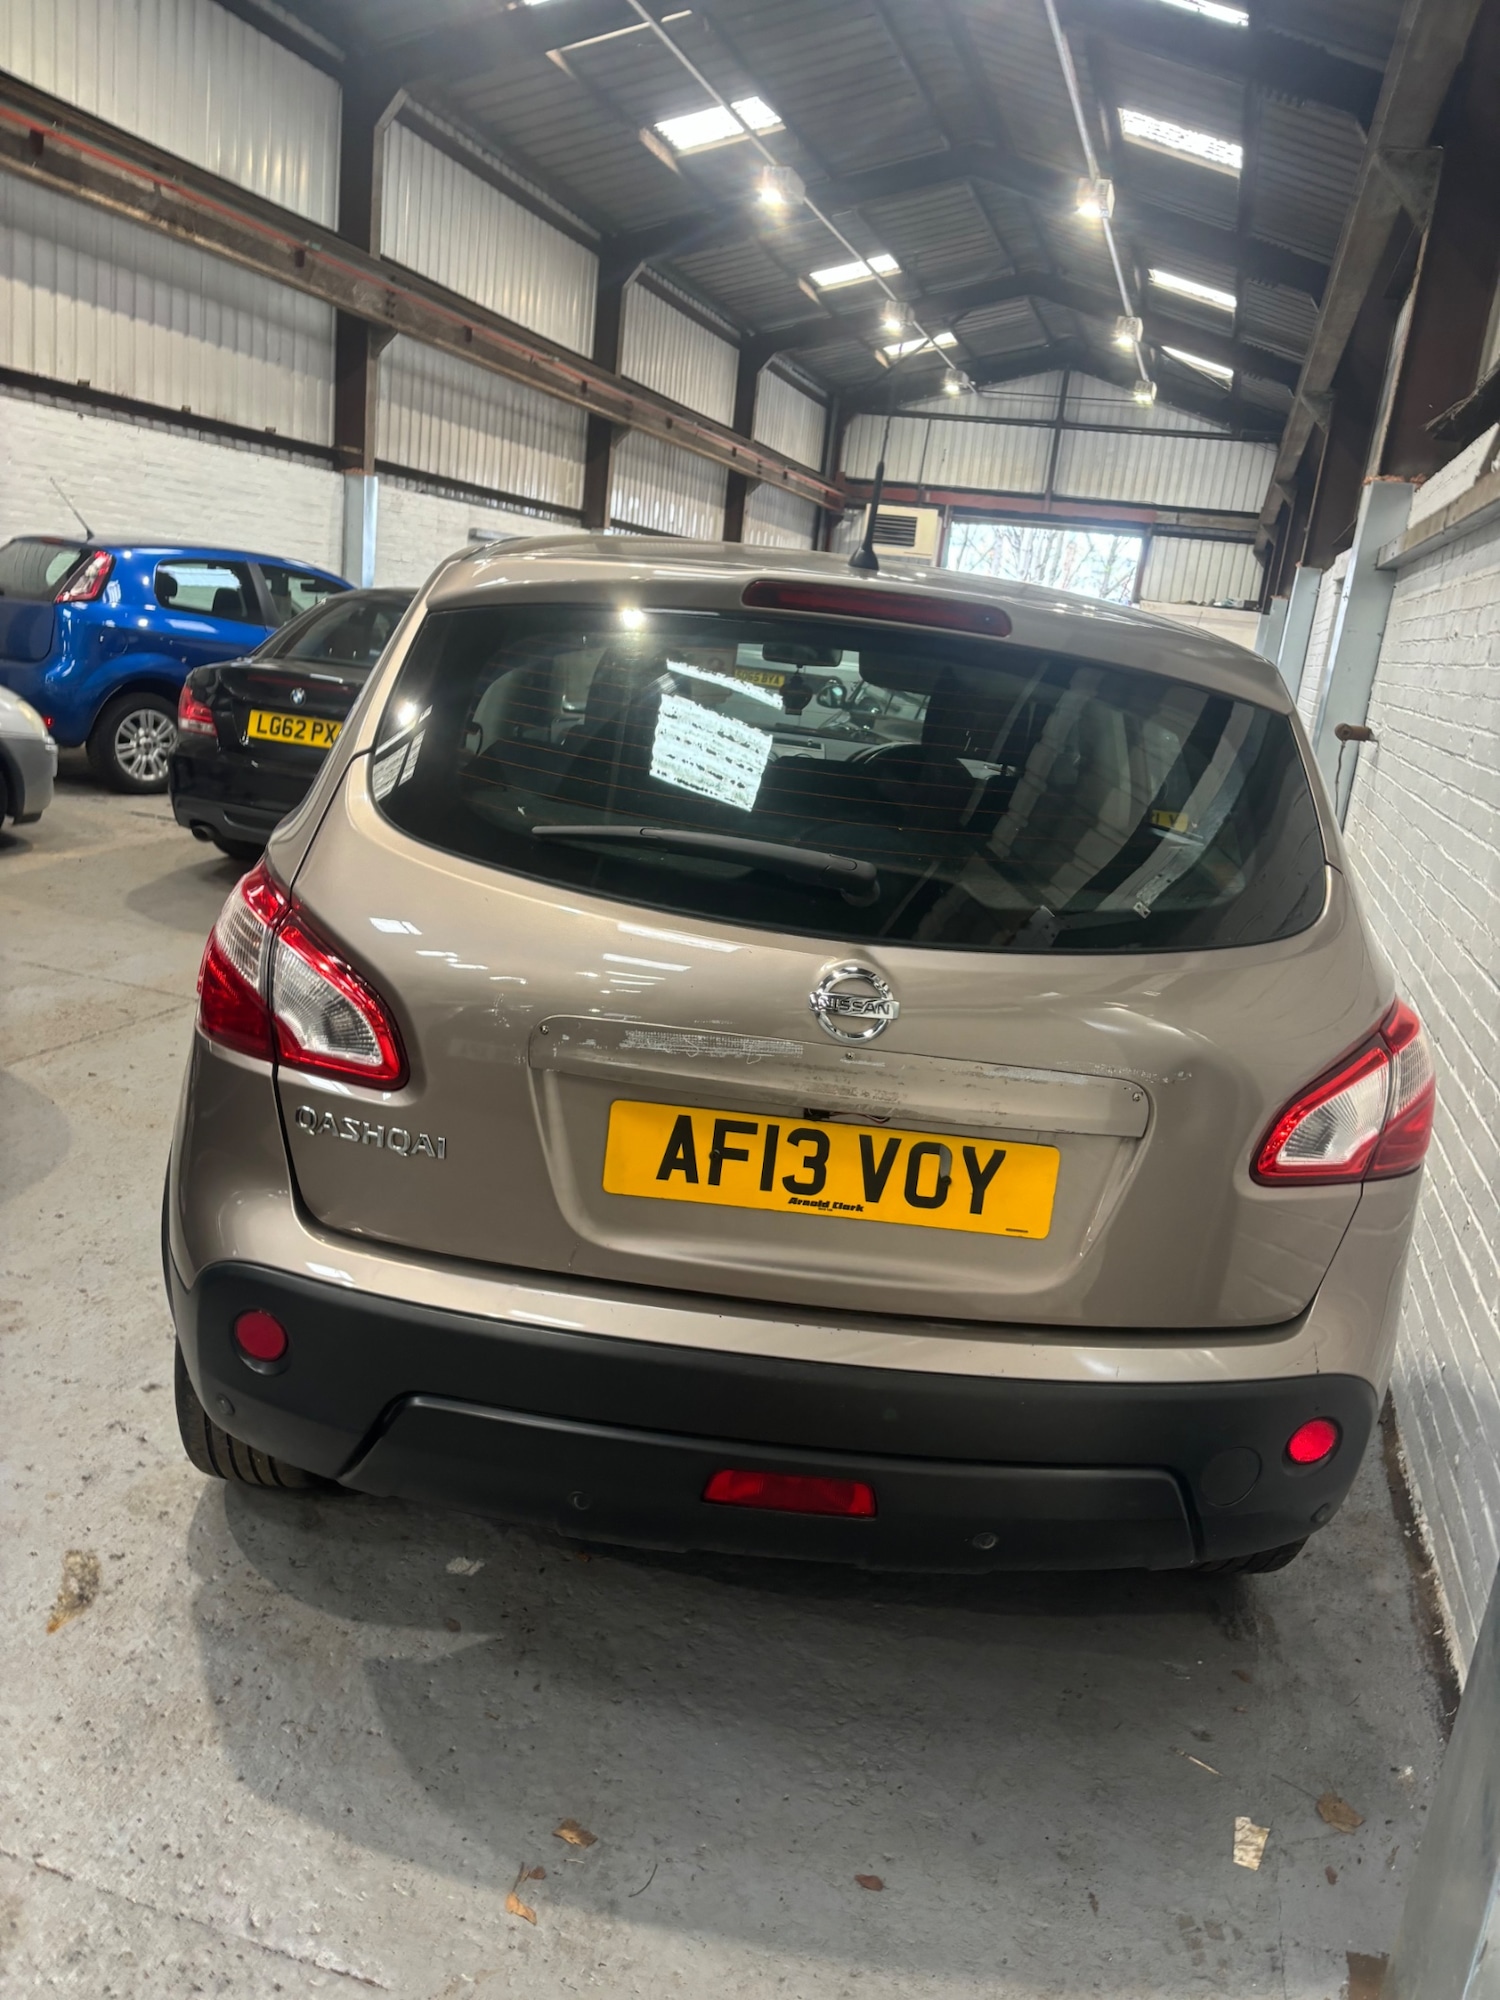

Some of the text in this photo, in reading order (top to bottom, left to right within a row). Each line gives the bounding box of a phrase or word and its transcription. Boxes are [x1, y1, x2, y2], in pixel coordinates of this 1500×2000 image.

[256, 714, 338, 744] LG62 PX
[820, 996, 889, 1015] NISSAN
[295, 1105, 446, 1159] QASHQAI
[656, 1115, 1006, 1215] AF13 VOY
[788, 1197, 831, 1208] Arnold
[832, 1202, 864, 1212] Clark
